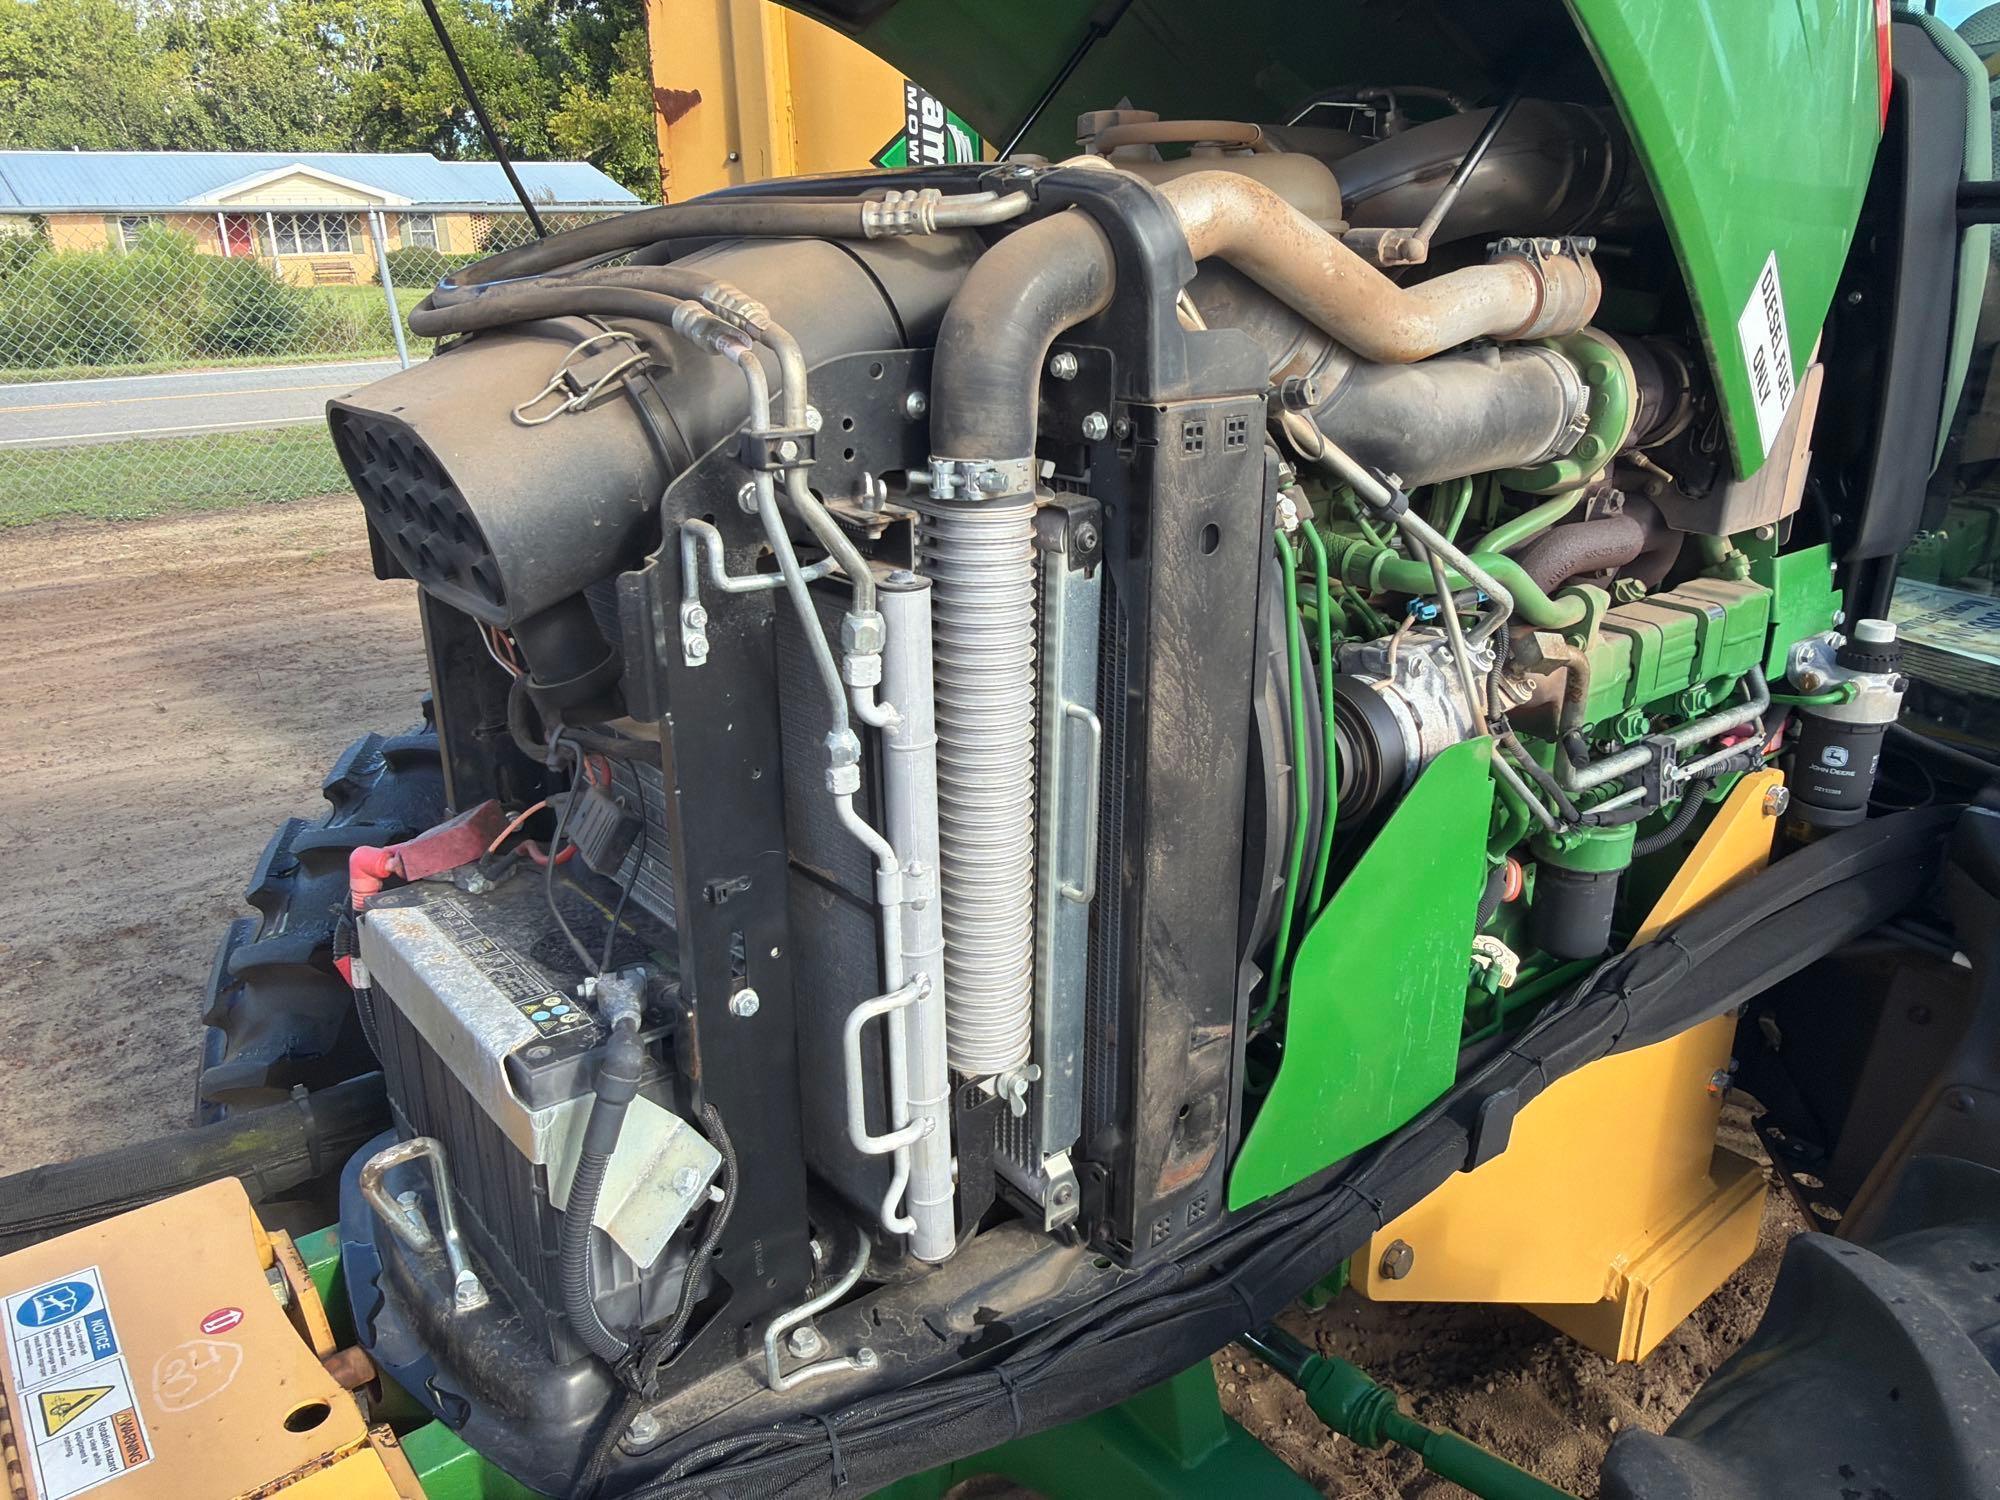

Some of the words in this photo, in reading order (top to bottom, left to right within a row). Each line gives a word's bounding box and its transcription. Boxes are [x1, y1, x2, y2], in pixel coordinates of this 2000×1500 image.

[921, 90, 944, 165] am
[1761, 265, 1783, 360] DIESEL
[1775, 348, 1793, 411] FUEL
[1752, 344, 1771, 407] ONLY
[1829, 768, 1856, 777] DEERE
[91, 1318, 110, 1351] NOTICE
[74, 1432, 87, 1459] equipment
[93, 1452, 102, 1466] while
[97, 1421, 111, 1450] Rotation
[104, 1448, 118, 1473] Hazard
[119, 1419, 143, 1464] WARNING
